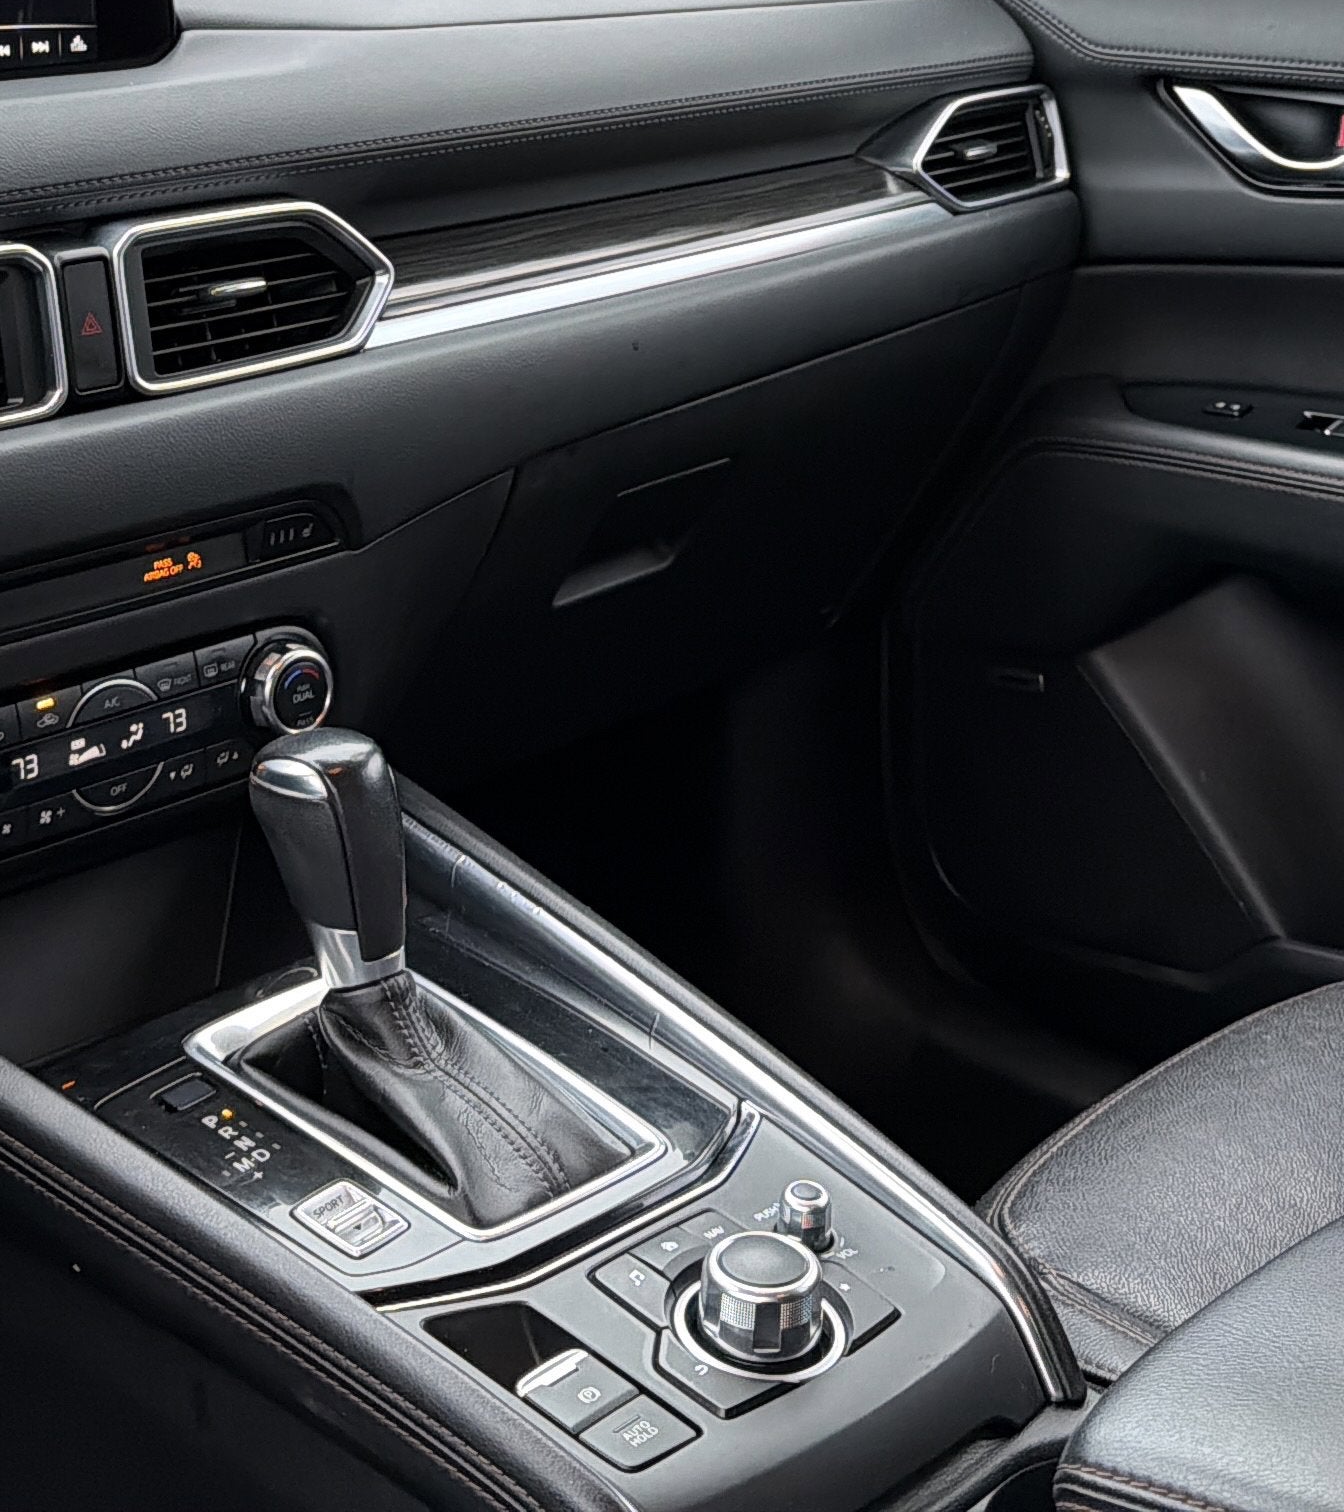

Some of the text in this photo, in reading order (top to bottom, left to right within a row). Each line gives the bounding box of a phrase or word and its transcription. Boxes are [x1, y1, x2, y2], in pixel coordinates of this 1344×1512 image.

[153, 557, 173, 570] PASS
[143, 563, 184, 582] AIRBAG OFF
[104, 696, 121, 709] A/C
[292, 690, 316, 704] DUAL
[161, 708, 187, 733] 73
[11, 753, 40, 780] 73
[110, 782, 128, 796] OFF
[201, 1115, 219, 1129] P
[218, 1125, 239, 1139] R
[233, 1135, 257, 1152] N
[312, 1194, 346, 1220] SPORT
[753, 1202, 781, 1222] PUSH
[703, 1225, 725, 1240] NAV
[836, 1246, 859, 1260] VOL
[622, 1420, 651, 1442] AUTO
[629, 1426, 659, 1448] HOLD
